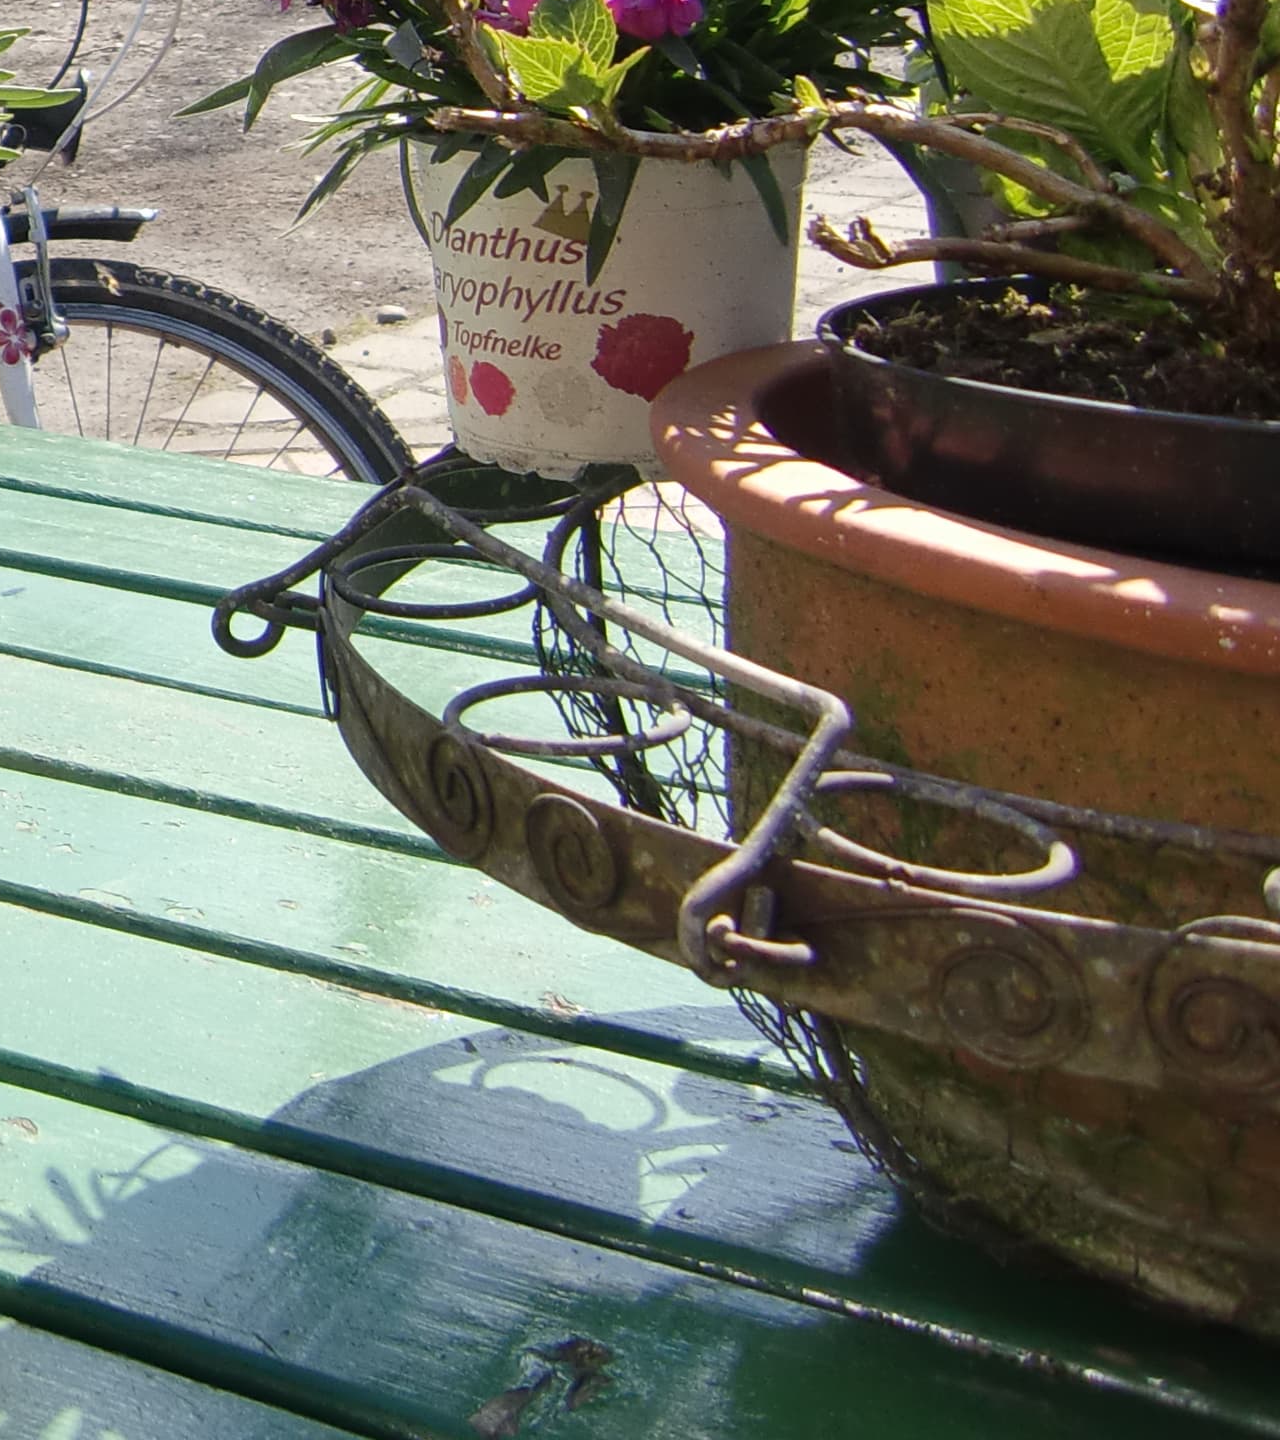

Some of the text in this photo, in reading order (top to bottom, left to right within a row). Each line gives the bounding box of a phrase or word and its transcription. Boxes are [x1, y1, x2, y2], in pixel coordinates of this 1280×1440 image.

[432, 211, 588, 265] Dianthus
[435, 266, 626, 323] aryophyllus
[454, 320, 562, 360] Topfnelke
